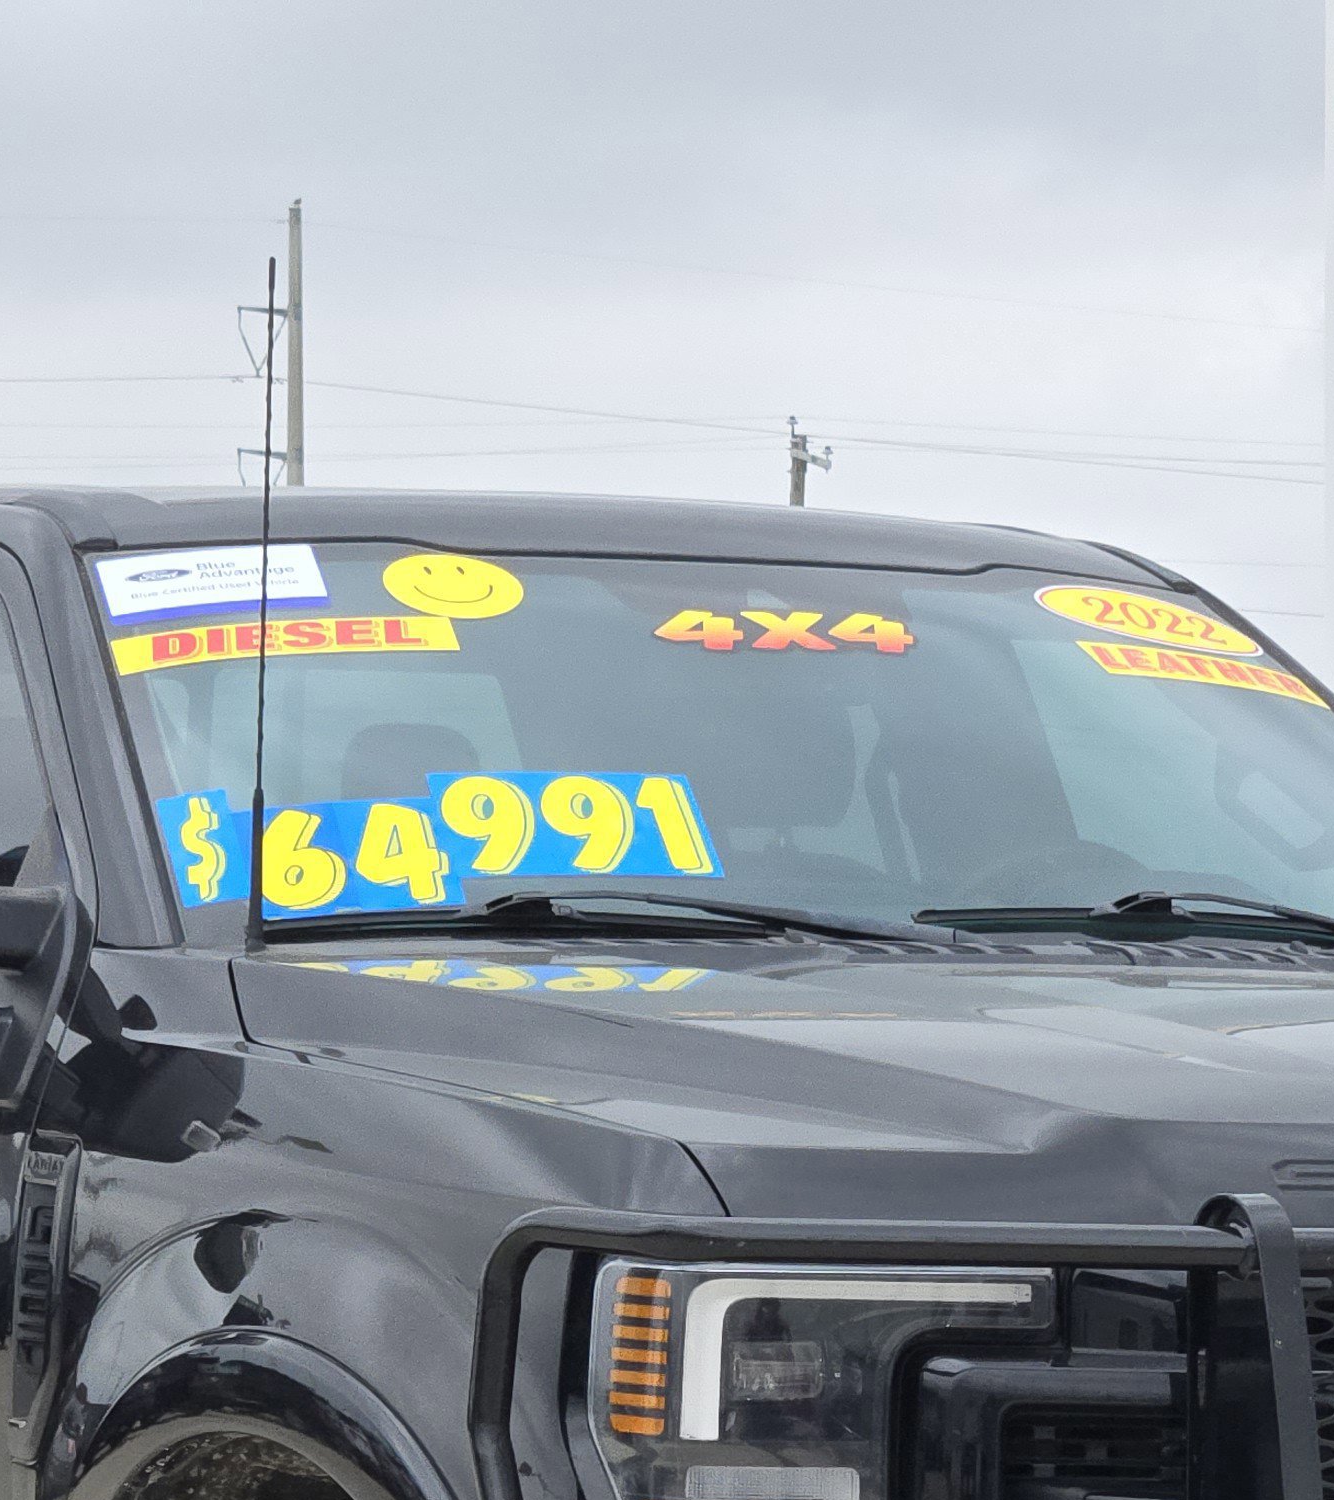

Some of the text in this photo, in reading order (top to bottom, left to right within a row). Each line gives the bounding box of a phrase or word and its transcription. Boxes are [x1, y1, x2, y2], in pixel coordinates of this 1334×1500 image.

[196, 561, 235, 571] Blue
[199, 565, 295, 580] Advantge
[255, 578, 299, 587] Vhicle
[152, 618, 429, 662] DIESEL
[653, 609, 913, 653] 4X4
[1082, 596, 1227, 645] 2022
[1092, 645, 1313, 702] LEATHER
